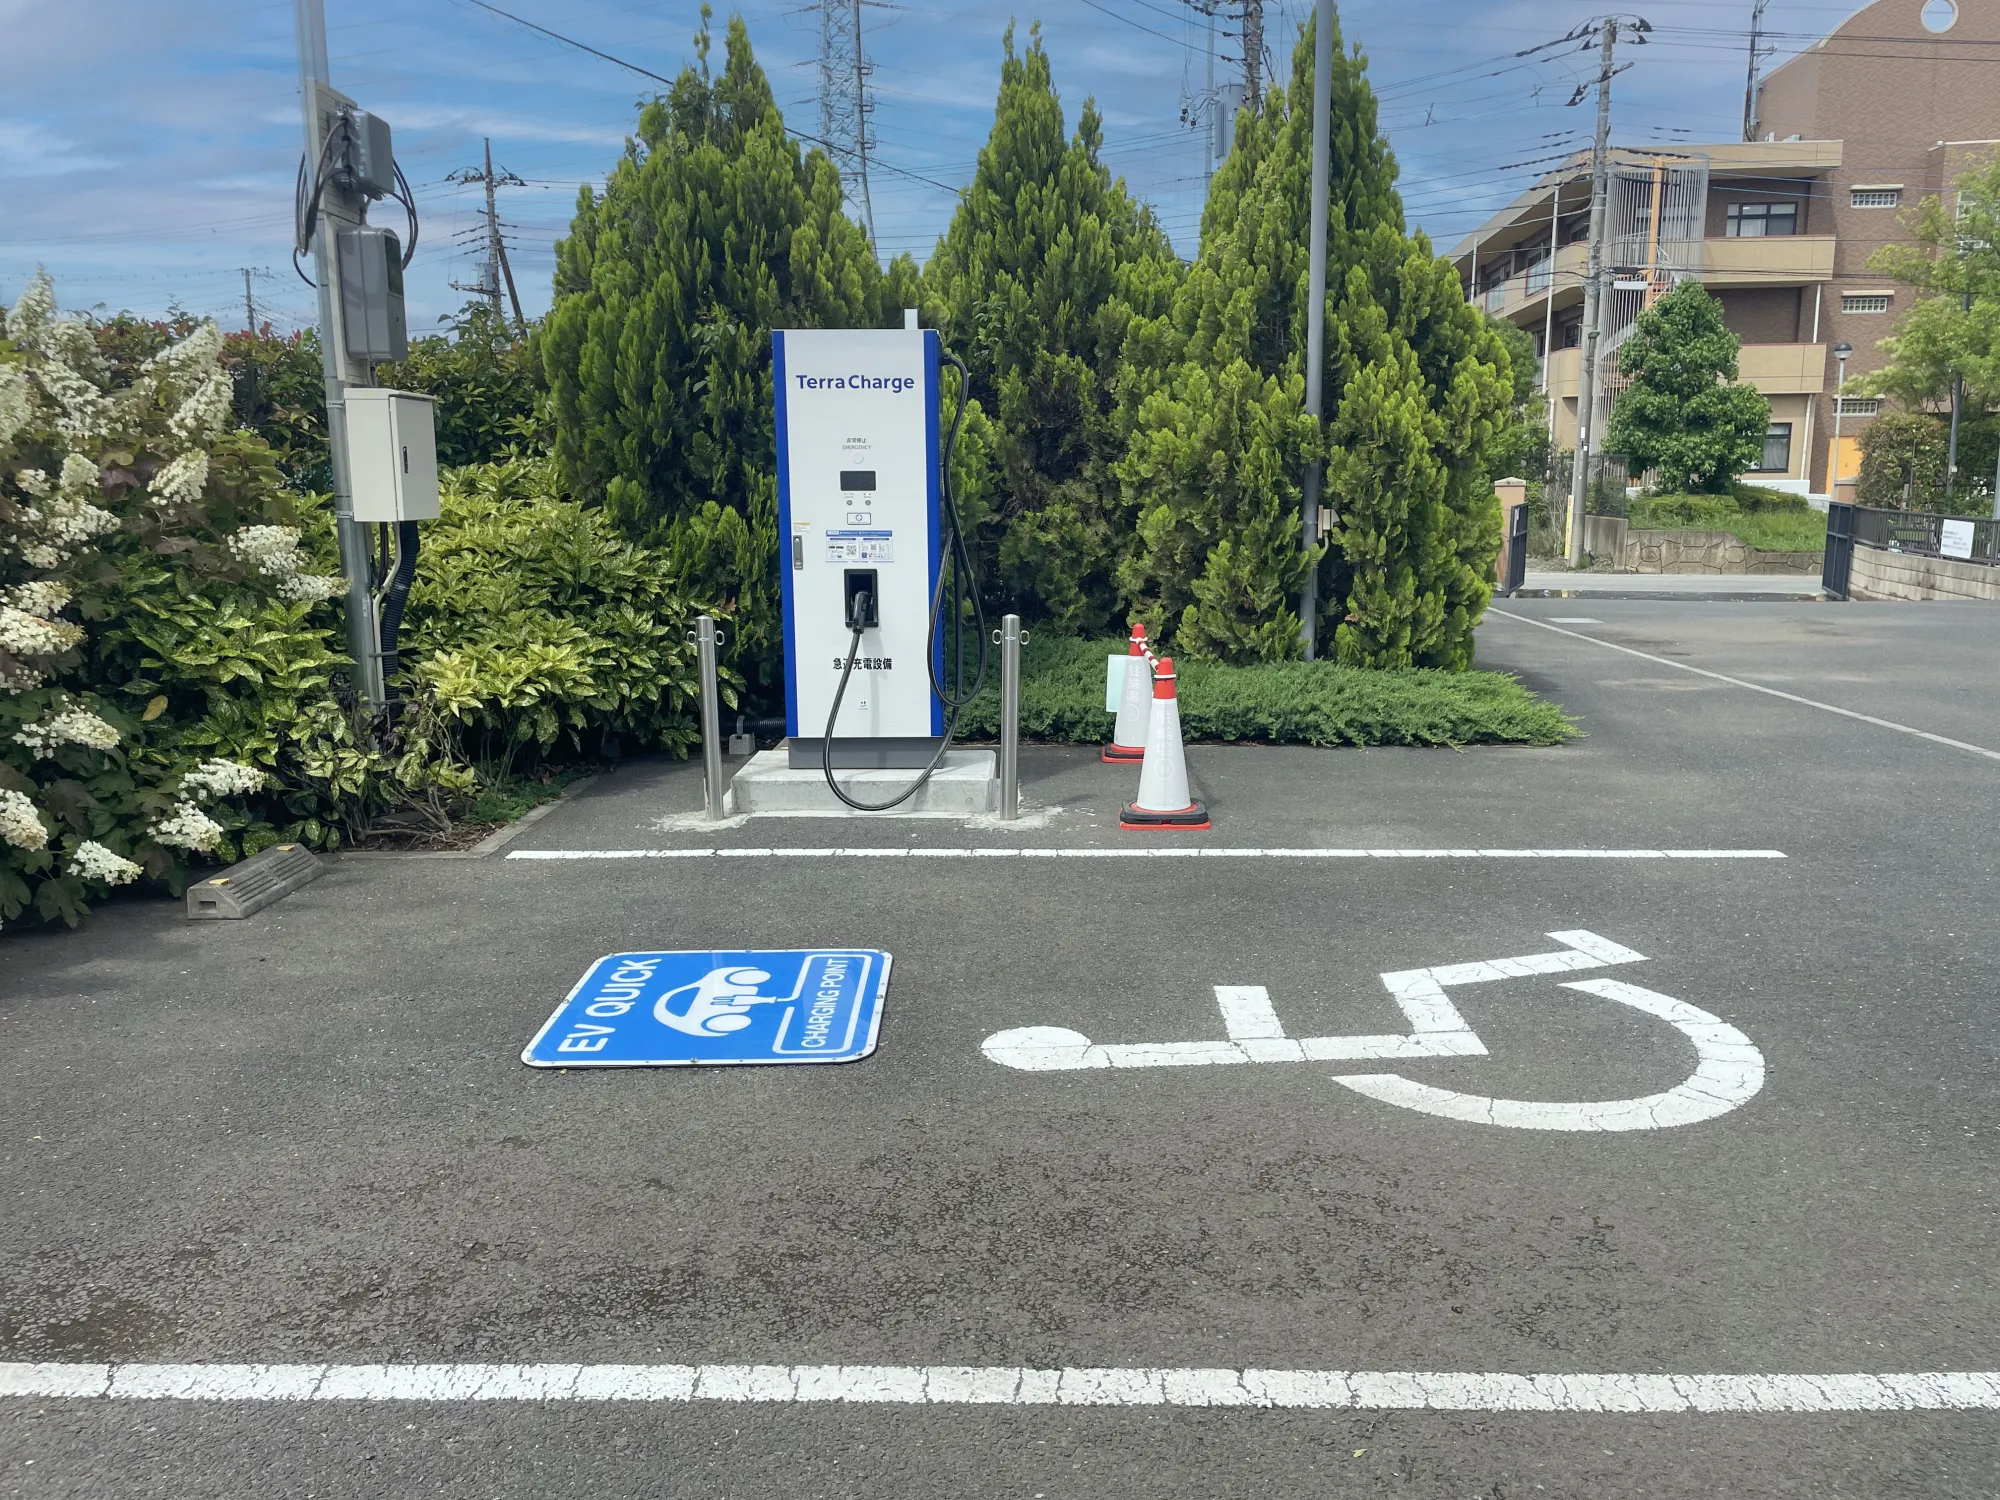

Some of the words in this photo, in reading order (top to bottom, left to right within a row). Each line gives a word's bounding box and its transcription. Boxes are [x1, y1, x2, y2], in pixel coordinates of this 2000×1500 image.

[796, 375, 845, 389] Terra
[848, 375, 915, 393] Charge
[585, 958, 662, 1018] QUICK
[800, 989, 840, 1048] CHARGING
[820, 958, 849, 988] POINT
[557, 1023, 616, 1052] EV
